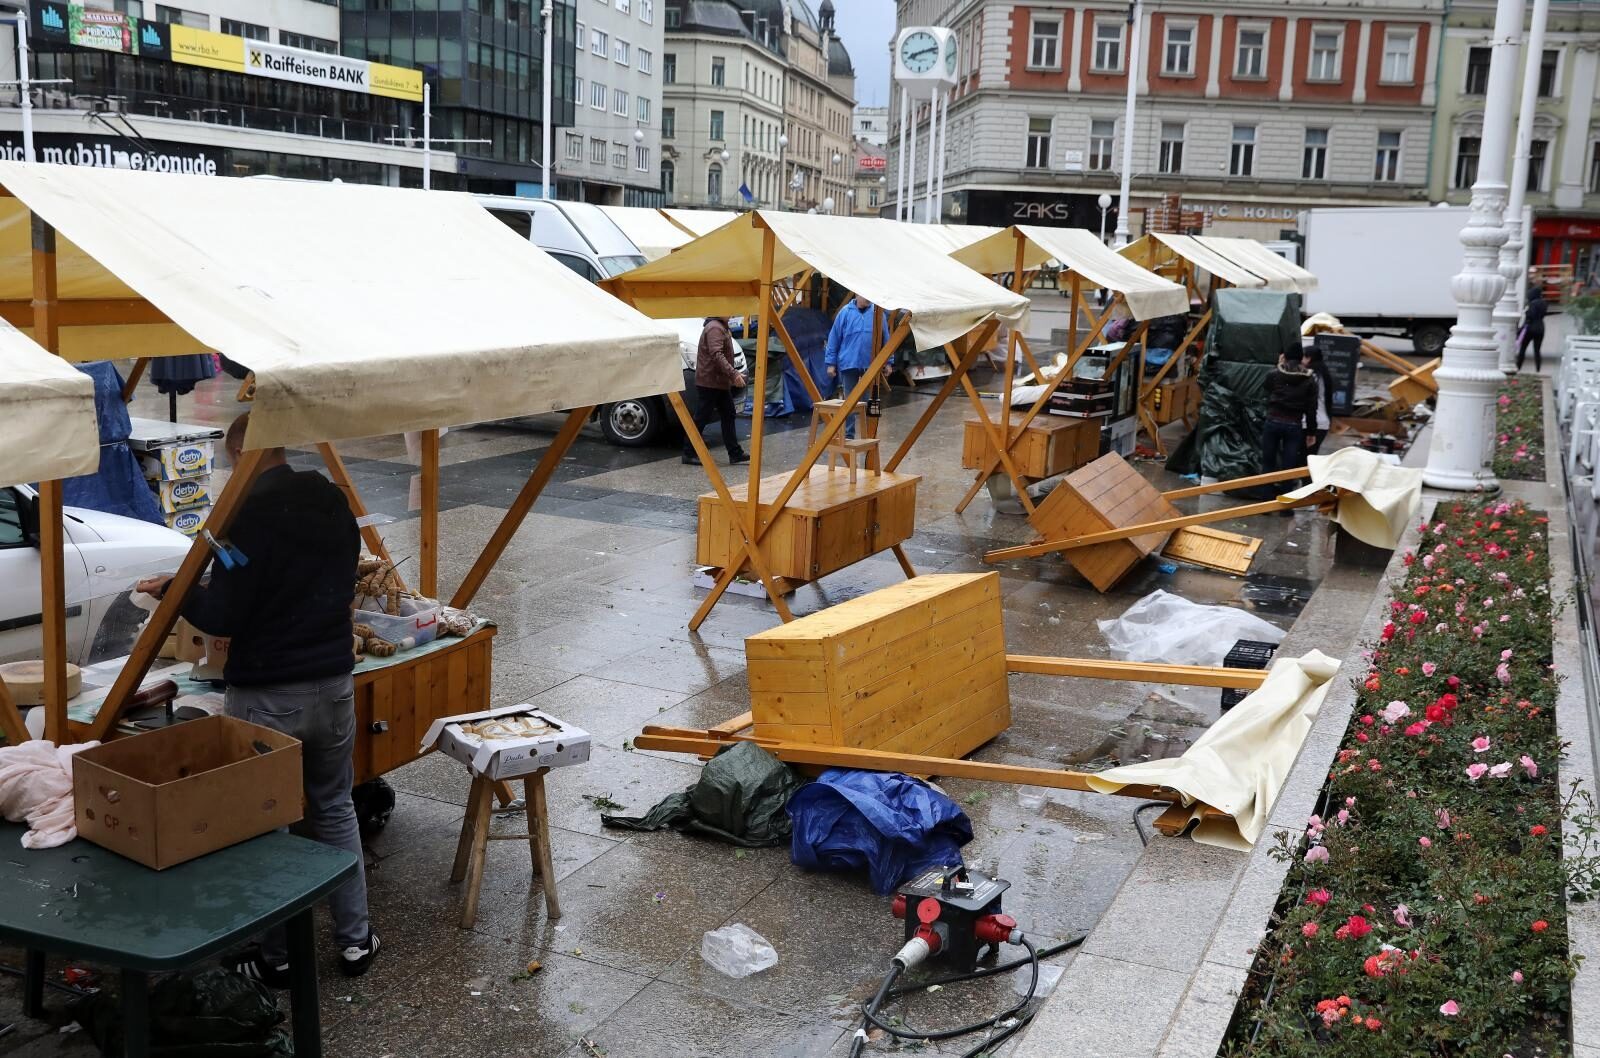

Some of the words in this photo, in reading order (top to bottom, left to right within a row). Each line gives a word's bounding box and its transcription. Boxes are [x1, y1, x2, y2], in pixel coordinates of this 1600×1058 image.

[264, 54, 327, 78] Raiffeisen
[329, 65, 364, 85] BANK
[1013, 202, 1069, 220] ZAKS
[180, 450, 201, 463] derby
[175, 483, 198, 496] derby
[177, 516, 199, 527] derby
[104, 814, 120, 831] CP
